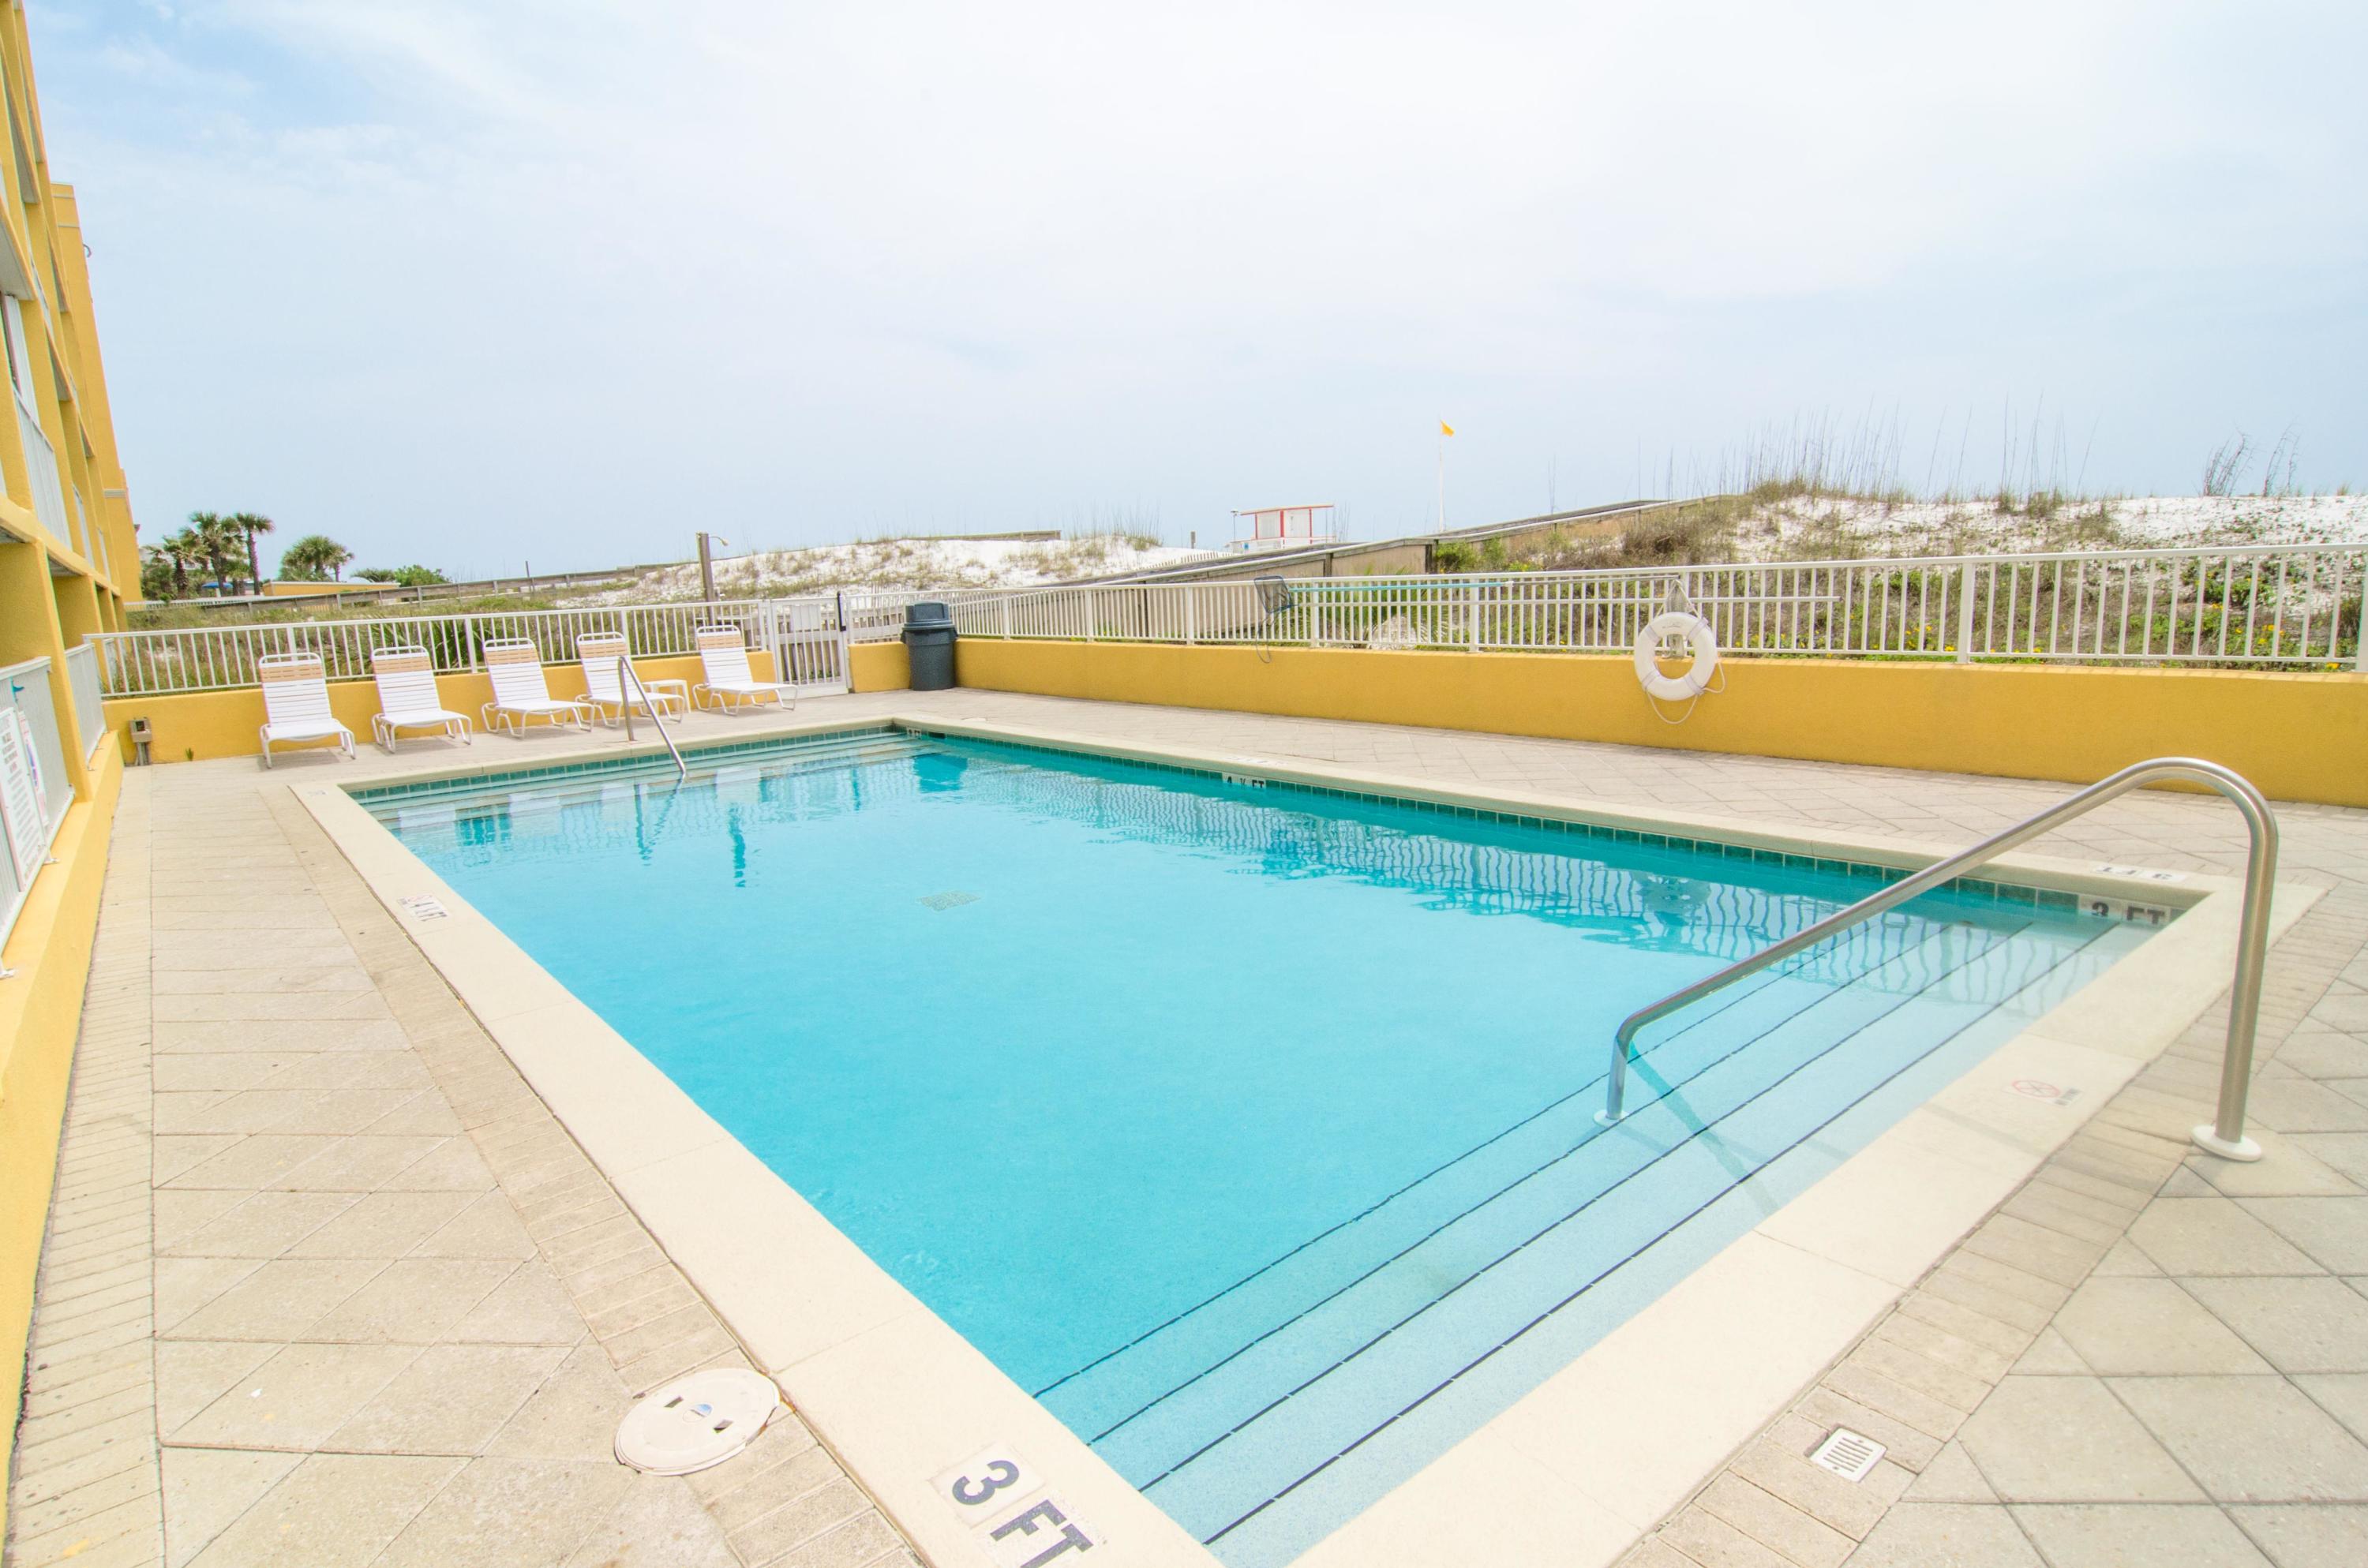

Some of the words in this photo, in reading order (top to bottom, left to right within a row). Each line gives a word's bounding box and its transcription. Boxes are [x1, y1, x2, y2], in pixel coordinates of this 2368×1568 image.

[2126, 905, 2165, 924] FT
[952, 1460, 1019, 1506] 3
[990, 1499, 1093, 1568] FT
